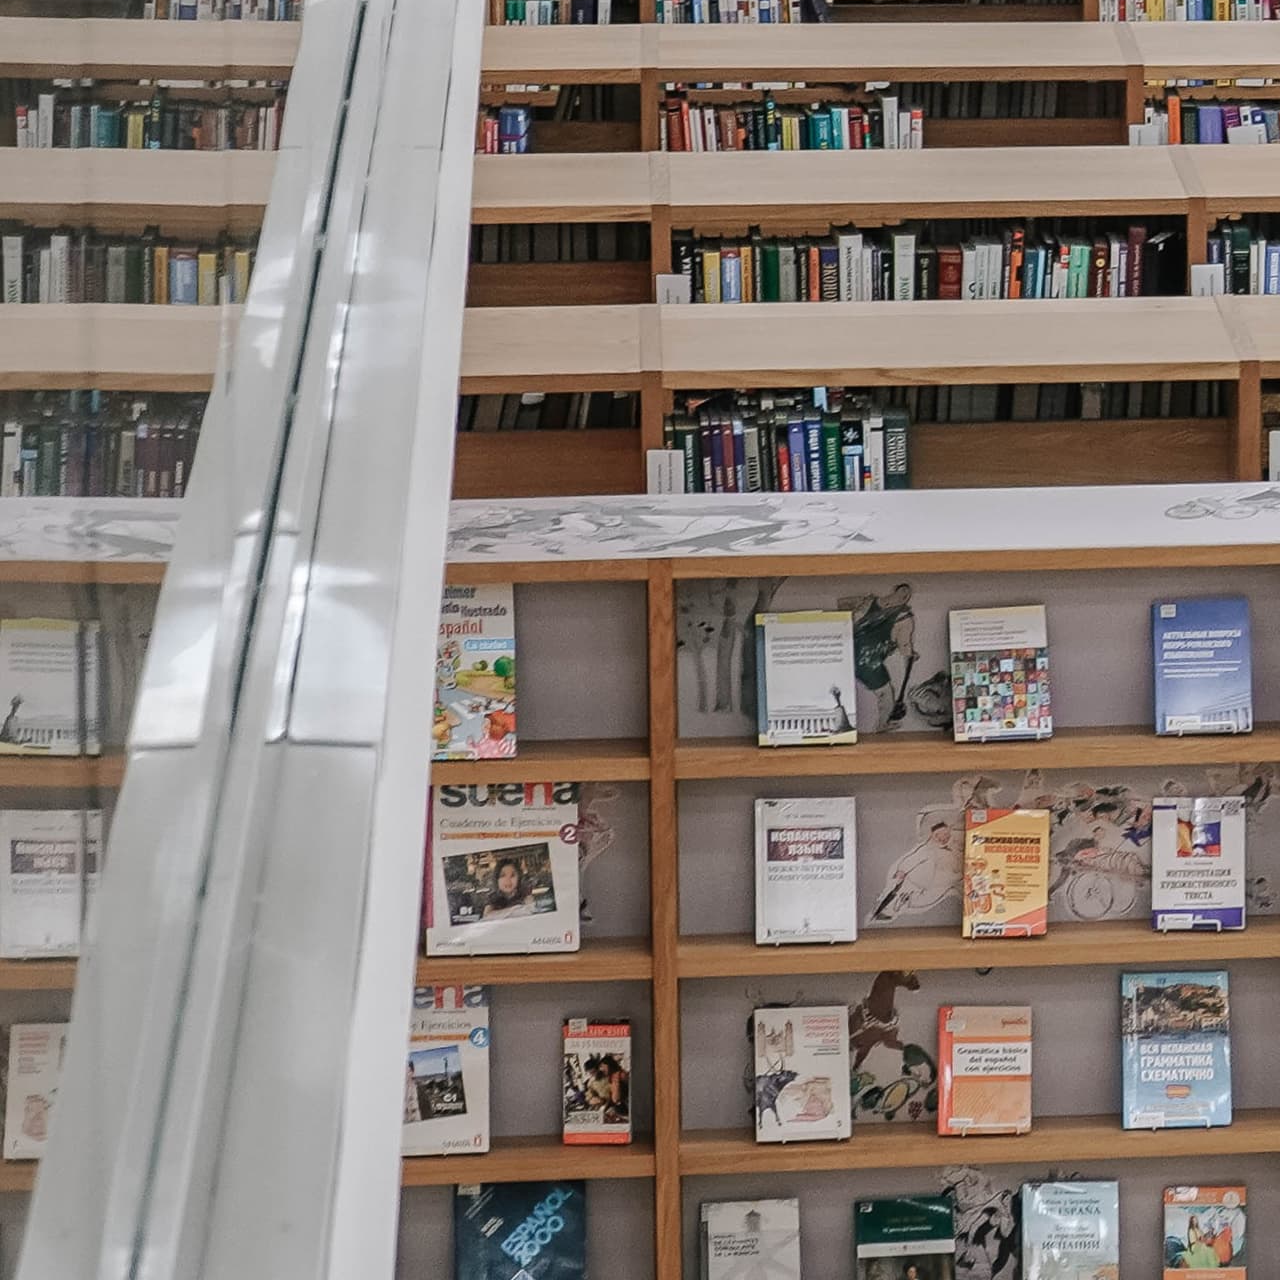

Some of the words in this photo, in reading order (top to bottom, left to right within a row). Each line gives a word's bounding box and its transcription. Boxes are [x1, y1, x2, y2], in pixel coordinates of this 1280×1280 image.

[439, 619, 483, 638] spañol
[439, 818, 491, 828] Cuaderno
[494, 818, 506, 827] de
[510, 817, 561, 828] Ejercicios
[564, 826, 576, 841] 2
[770, 829, 842, 842] ИСПАНСКИЙ
[788, 843, 825, 856] ЯЗЫК
[473, 1030, 486, 1045] 4
[1140, 1043, 1159, 1054] ВСЯ
[1161, 1042, 1213, 1054] ИСПАНСКАЯ
[1140, 1054, 1214, 1067] ГРАММАТИКА
[1141, 1068, 1214, 1082] СХЕМАТИЧНО
[1058, 1205, 1102, 1215] ESPAÑA
[501, 1189, 574, 1256] ESPAÑOL
[514, 1215, 564, 1268] 2000
[1042, 1240, 1101, 1251] ИСПАНИИ
